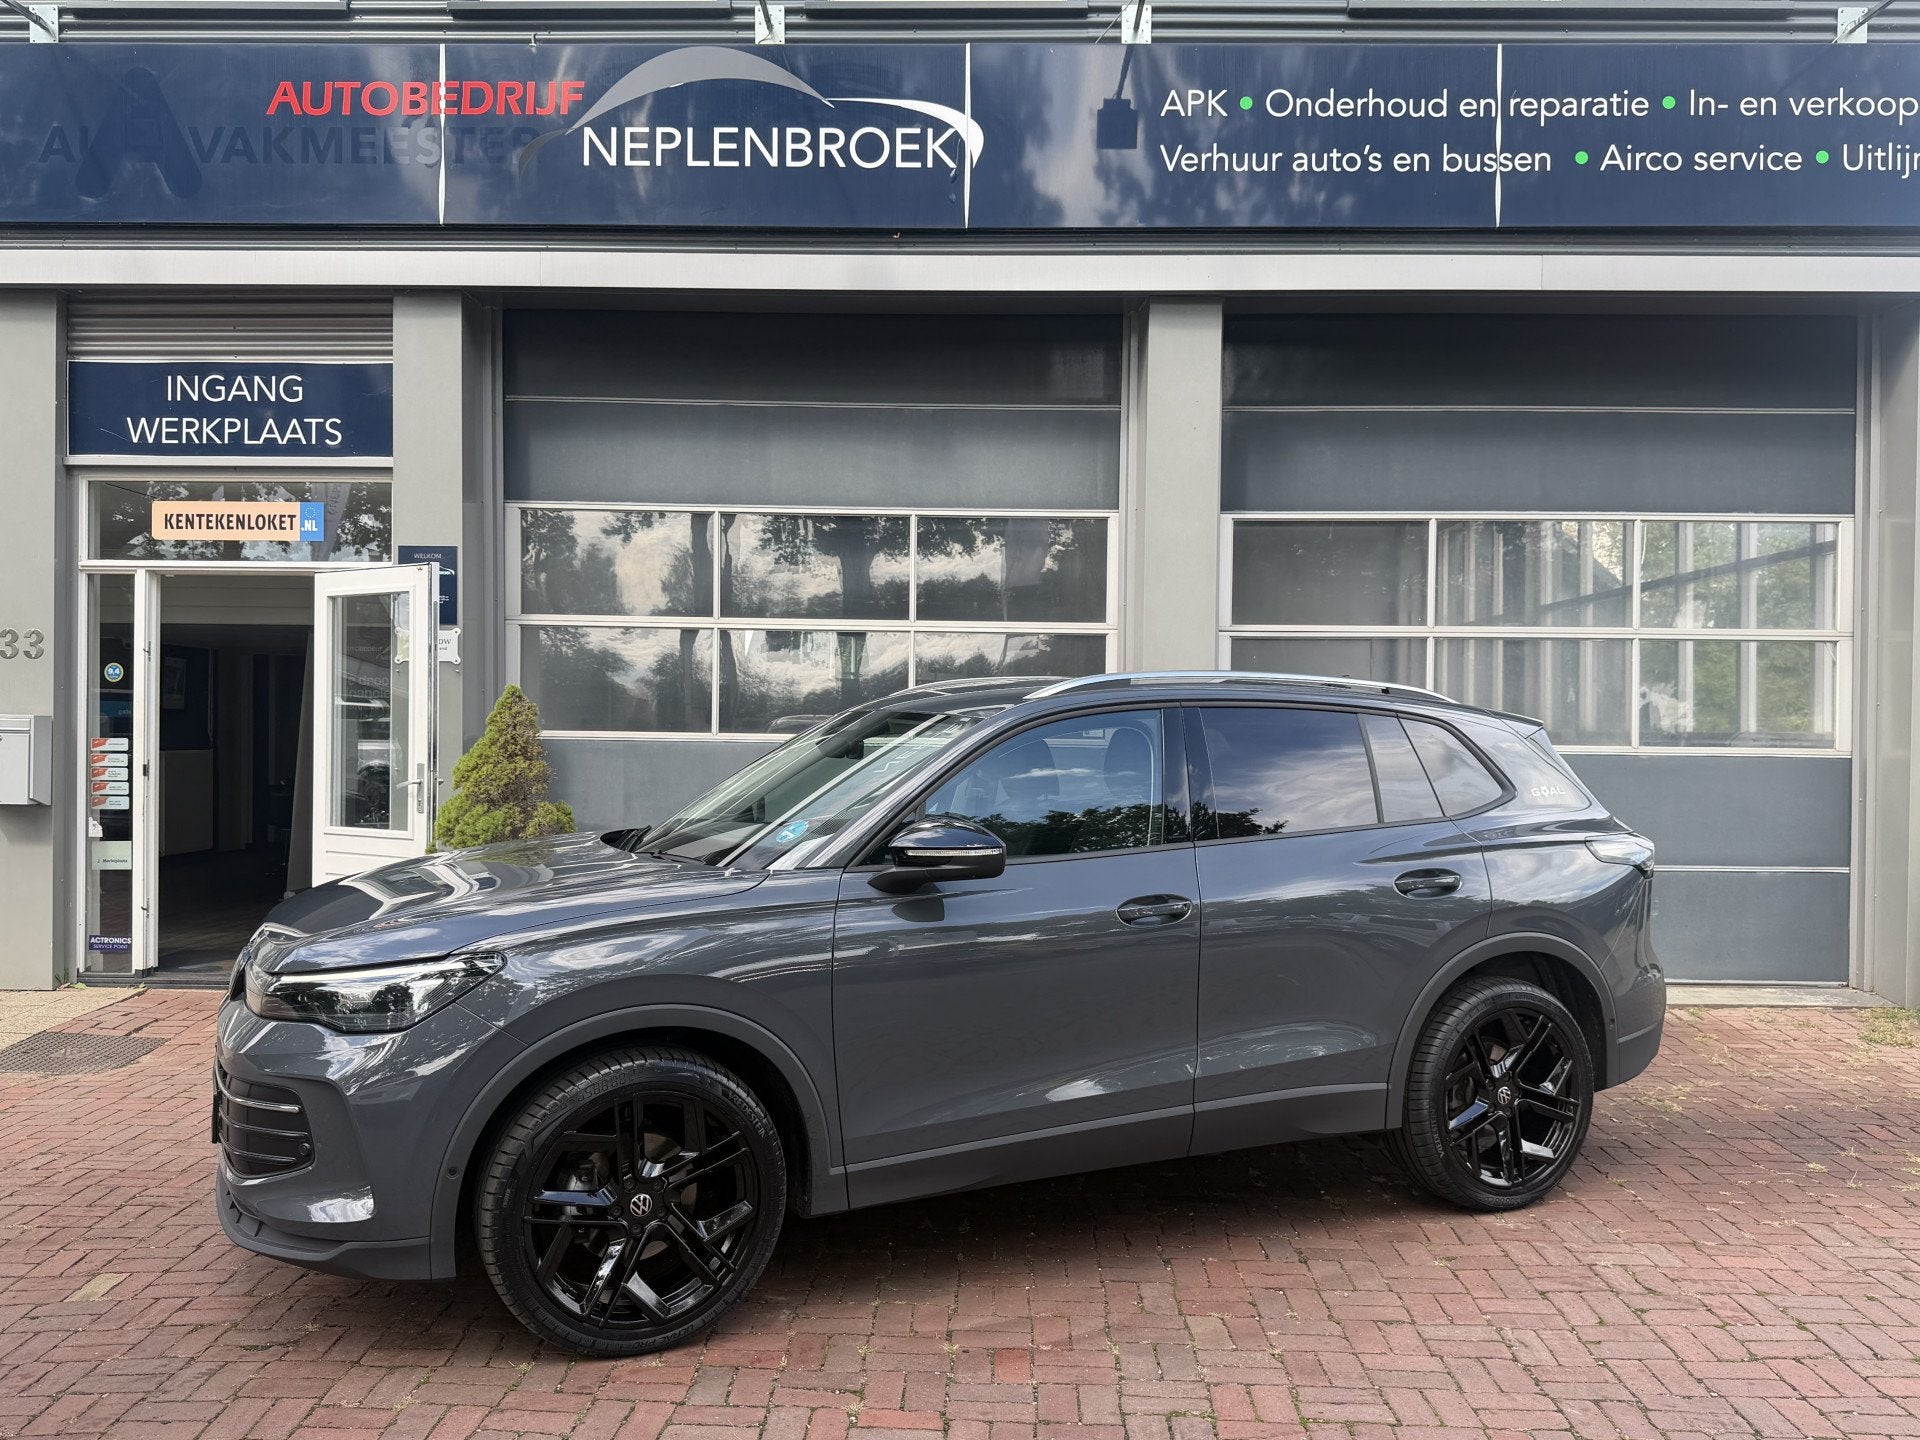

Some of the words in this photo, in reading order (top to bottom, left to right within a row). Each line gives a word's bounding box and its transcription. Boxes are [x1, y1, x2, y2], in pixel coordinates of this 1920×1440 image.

[267, 80, 585, 117] AUTOBEDRIJF
[1160, 90, 1228, 117] APK
[1265, 88, 1448, 118] Onderhoud
[1460, 97, 1495, 117] en
[1509, 90, 1650, 127] reparatie
[1689, 89, 1729, 117] In-
[1740, 97, 1777, 116] en
[1788, 87, 1919, 126] verkoop
[582, 126, 957, 170] NEPLENBROEK
[1159, 143, 1284, 172] Verhuur
[1393, 153, 1430, 172] en
[1443, 143, 1552, 172] bussen
[1599, 144, 1683, 172] Airco
[1693, 144, 1803, 172] service
[167, 374, 303, 403] INGANG
[126, 417, 342, 446] WERKPLAATS
[413, 552, 442, 560] WELKOM
[1531, 785, 1566, 798] GOAL
[90, 936, 132, 945] ACTRONICS
